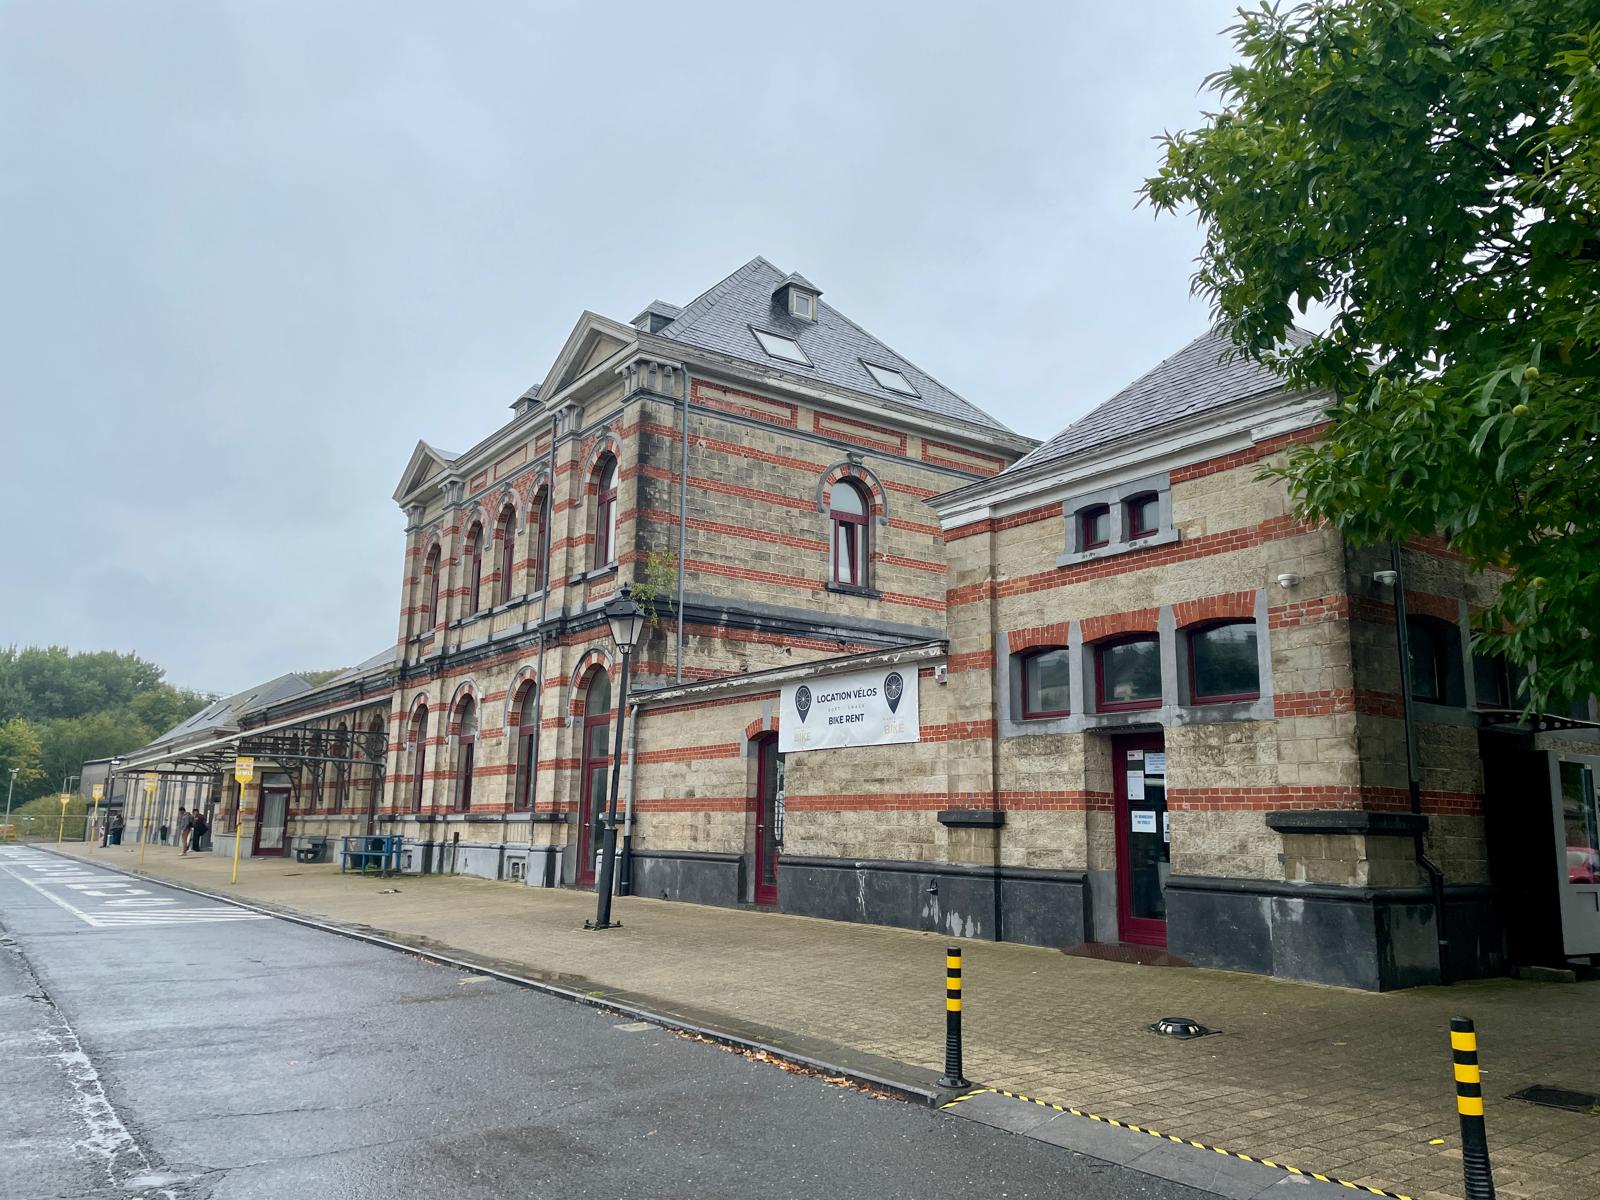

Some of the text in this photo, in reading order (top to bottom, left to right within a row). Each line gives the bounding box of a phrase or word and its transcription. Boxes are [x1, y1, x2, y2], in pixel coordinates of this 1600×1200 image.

[816, 687, 877, 704] LOCATION VÉLOS
[828, 713, 865, 725] BIKE RENT
[884, 723, 905, 735] BIKE
